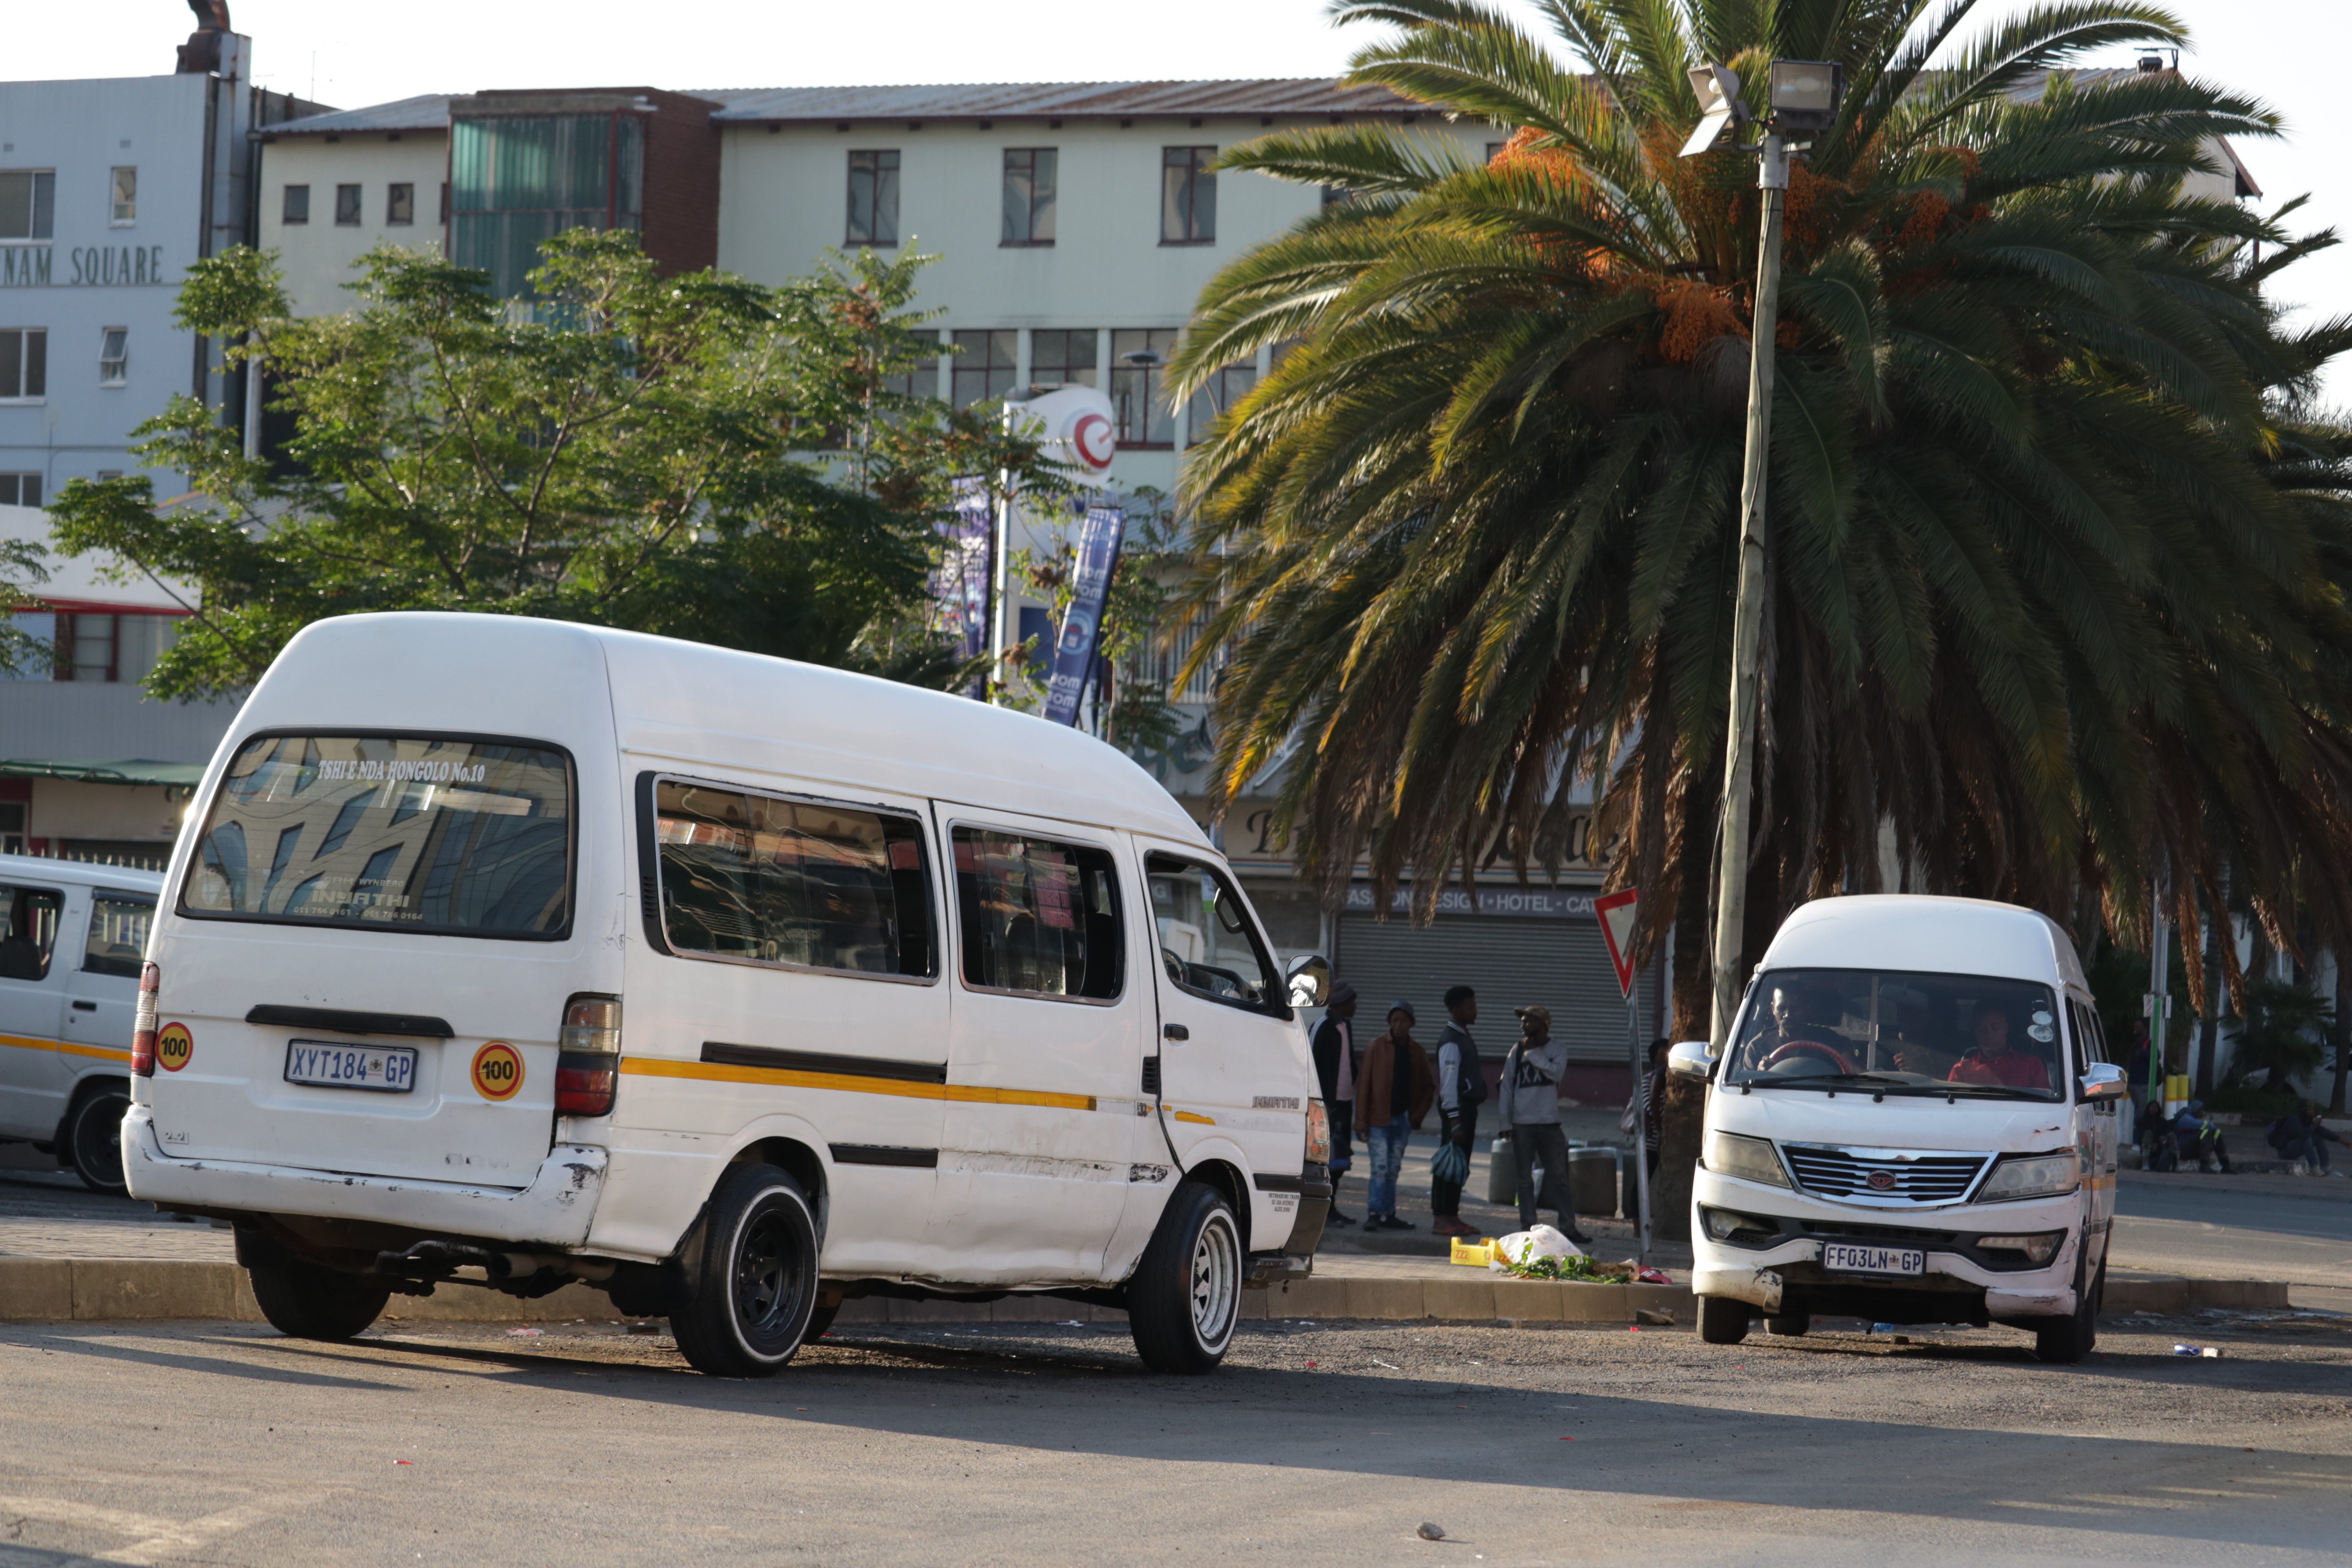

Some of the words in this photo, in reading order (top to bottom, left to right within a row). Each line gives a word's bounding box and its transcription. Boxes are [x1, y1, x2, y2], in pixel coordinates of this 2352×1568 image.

[71, 246, 163, 285] SQUARE
[318, 760, 347, 780] TSHI
[387, 761, 449, 781] HONGOLO
[450, 762, 485, 782] No.10
[359, 878, 405, 887] WYNBERG
[312, 890, 410, 907] INYATHI
[1497, 895, 1553, 913] HOTEL
[161, 1037, 187, 1057] 100
[292, 1048, 367, 1080] XYT184
[385, 1055, 410, 1083] GP
[482, 1061, 514, 1080] 100
[1252, 1096, 1299, 1109] INYATHI
[1455, 1249, 1468, 1260] ZZ2
[1827, 1247, 1887, 1269] FF03LN
[1902, 1252, 1921, 1271] GP
